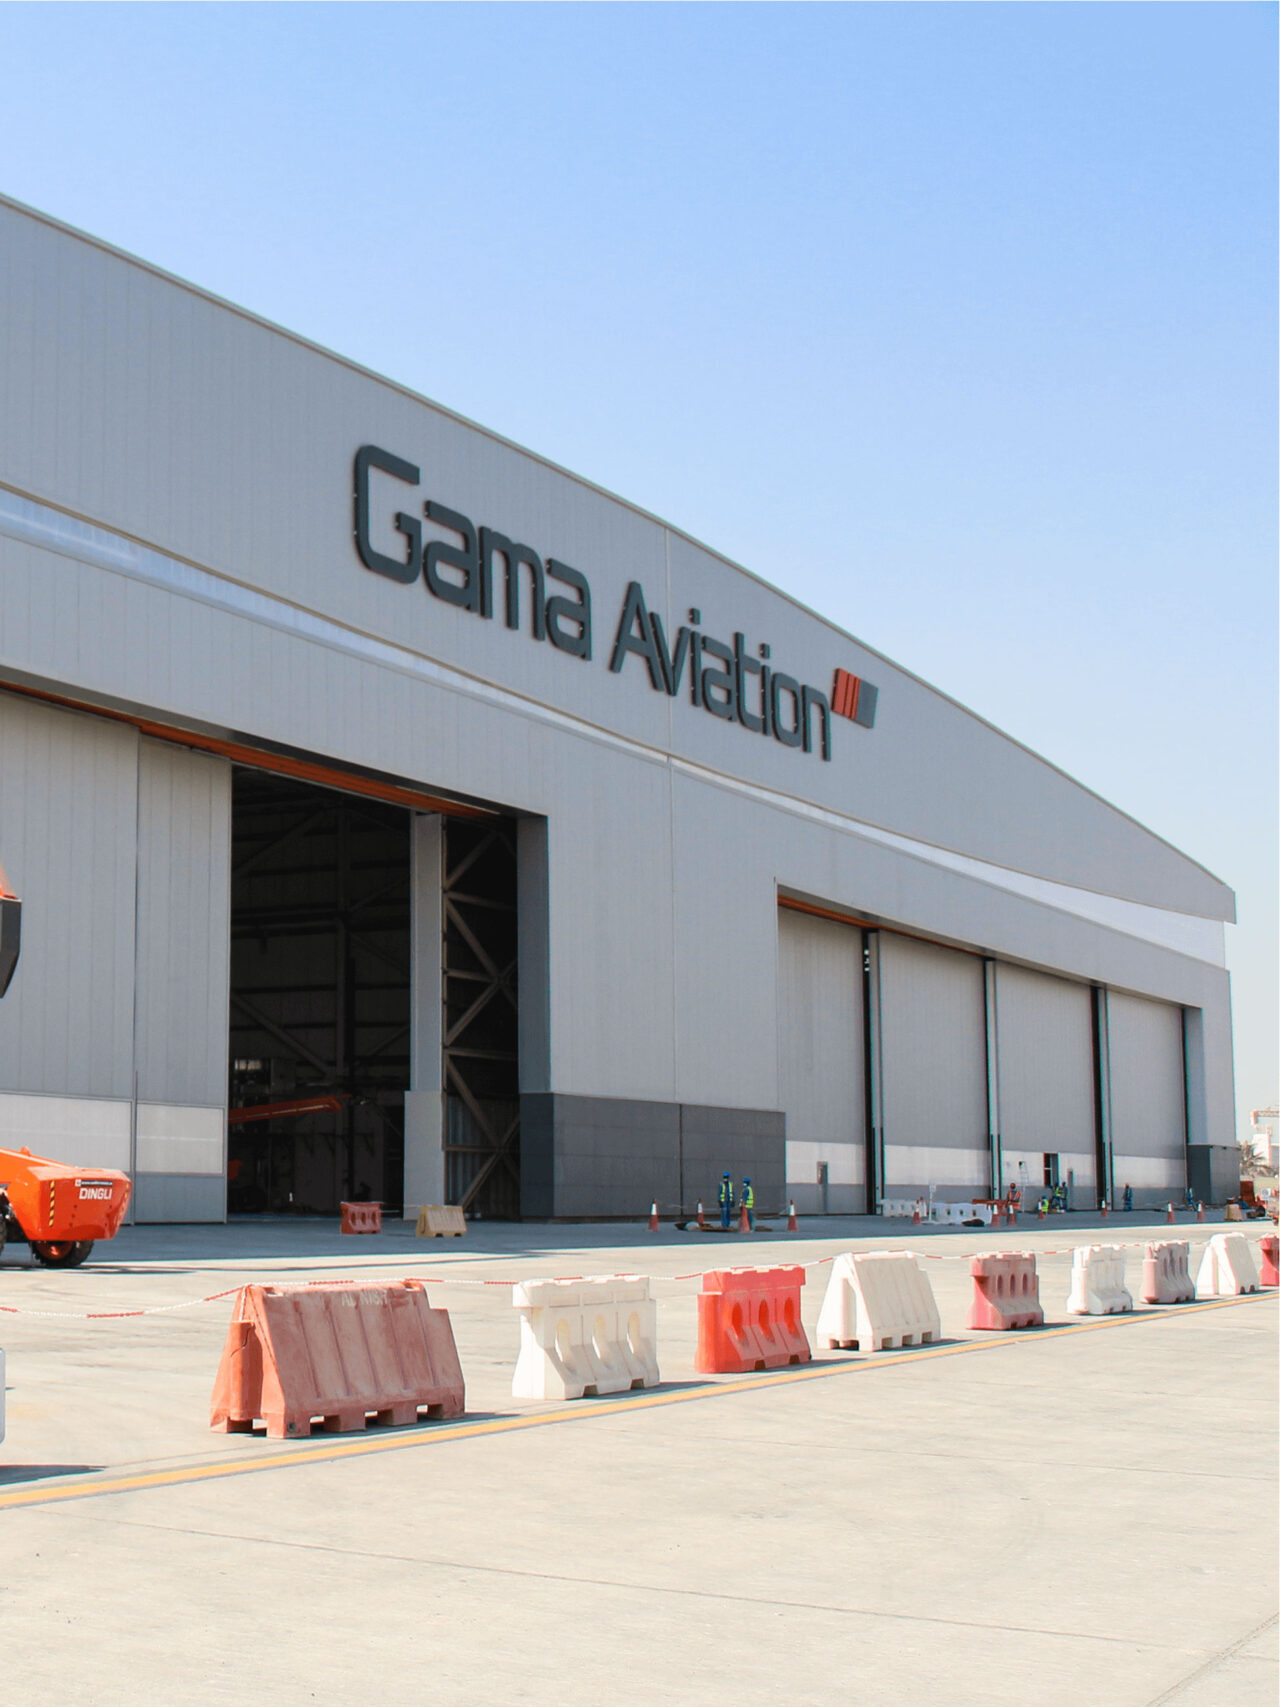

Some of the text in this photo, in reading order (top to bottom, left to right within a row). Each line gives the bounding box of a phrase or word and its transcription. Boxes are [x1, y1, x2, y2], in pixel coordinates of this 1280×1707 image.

[354, 445, 831, 761] Gama Aviation
[79, 1187, 112, 1200] DINGLI
